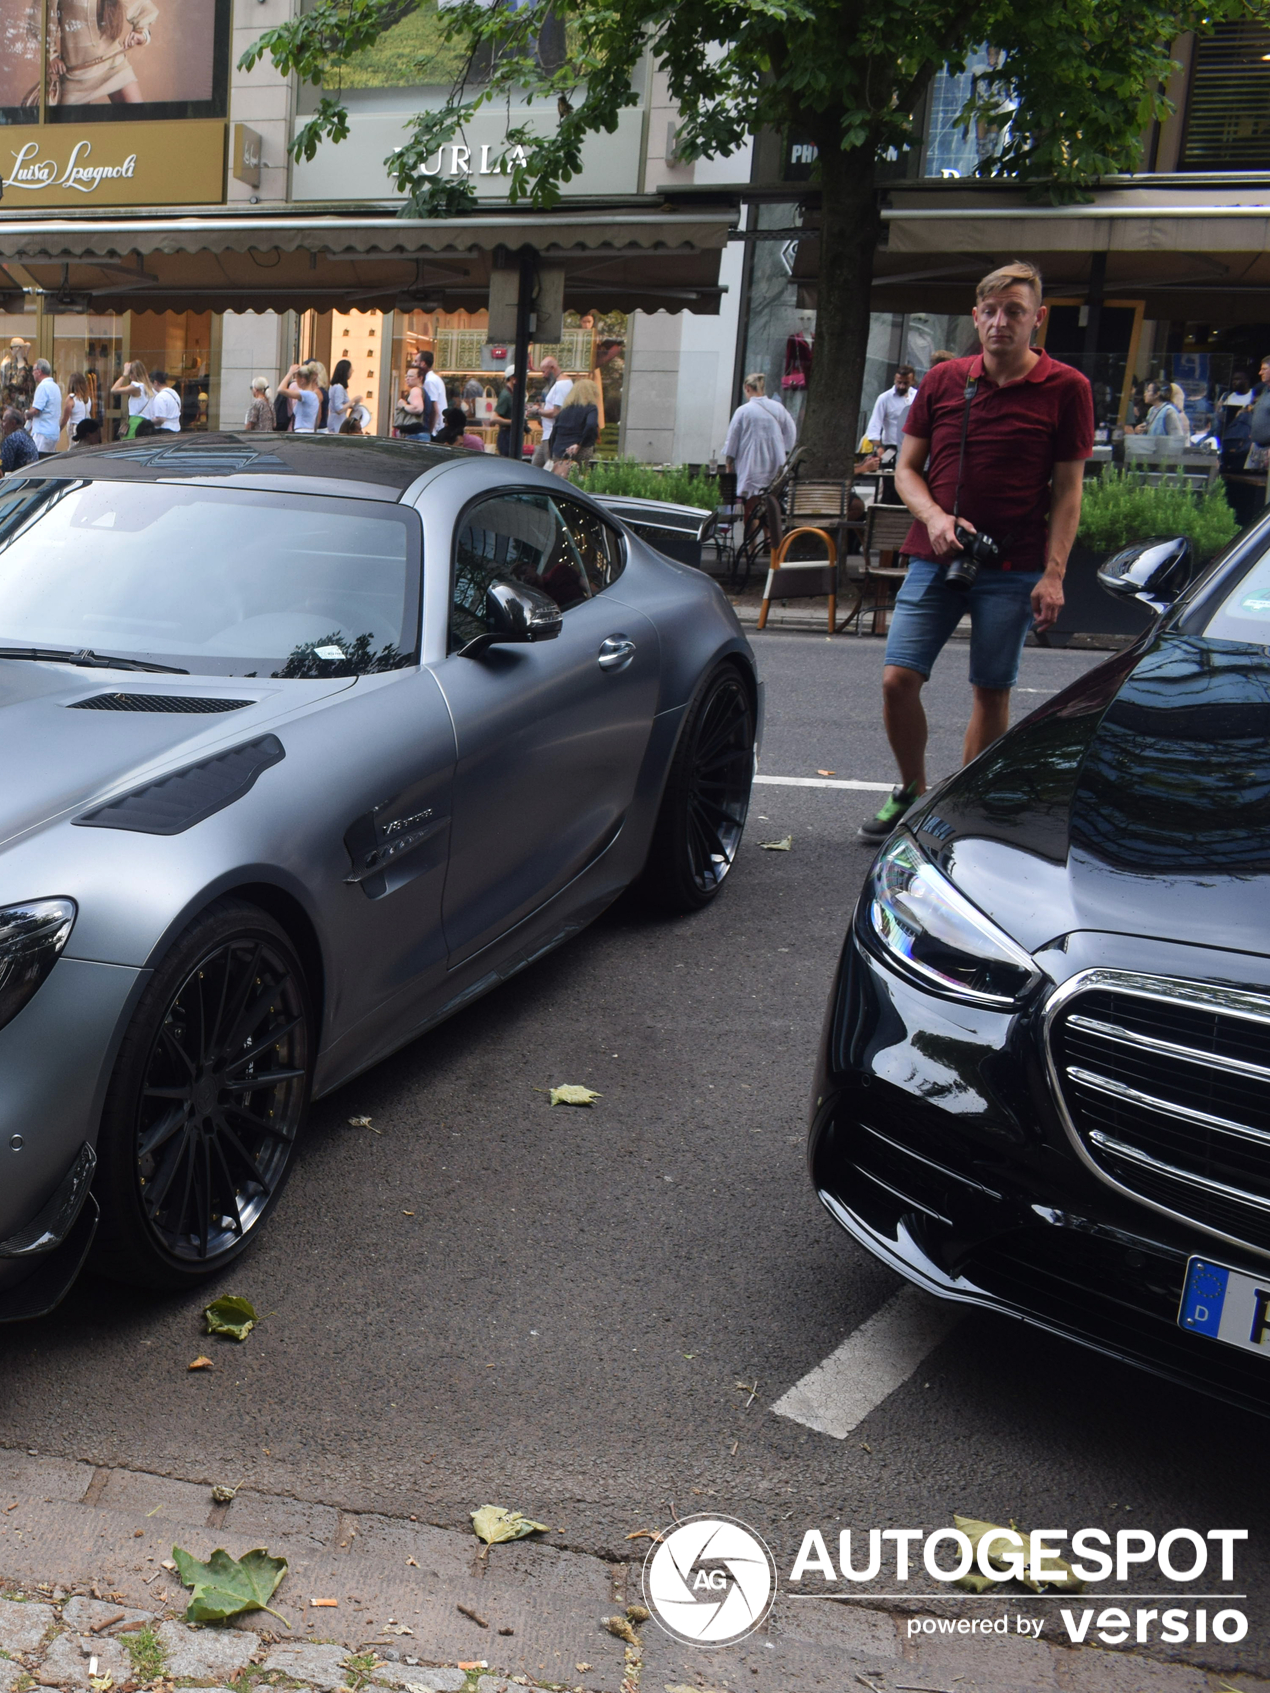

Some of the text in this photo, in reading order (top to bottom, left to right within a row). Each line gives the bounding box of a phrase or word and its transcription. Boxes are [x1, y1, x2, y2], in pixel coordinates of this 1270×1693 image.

[2, 142, 58, 189] Luisa
[392, 144, 528, 177] URLA
[1194, 1304, 1209, 1322] D
